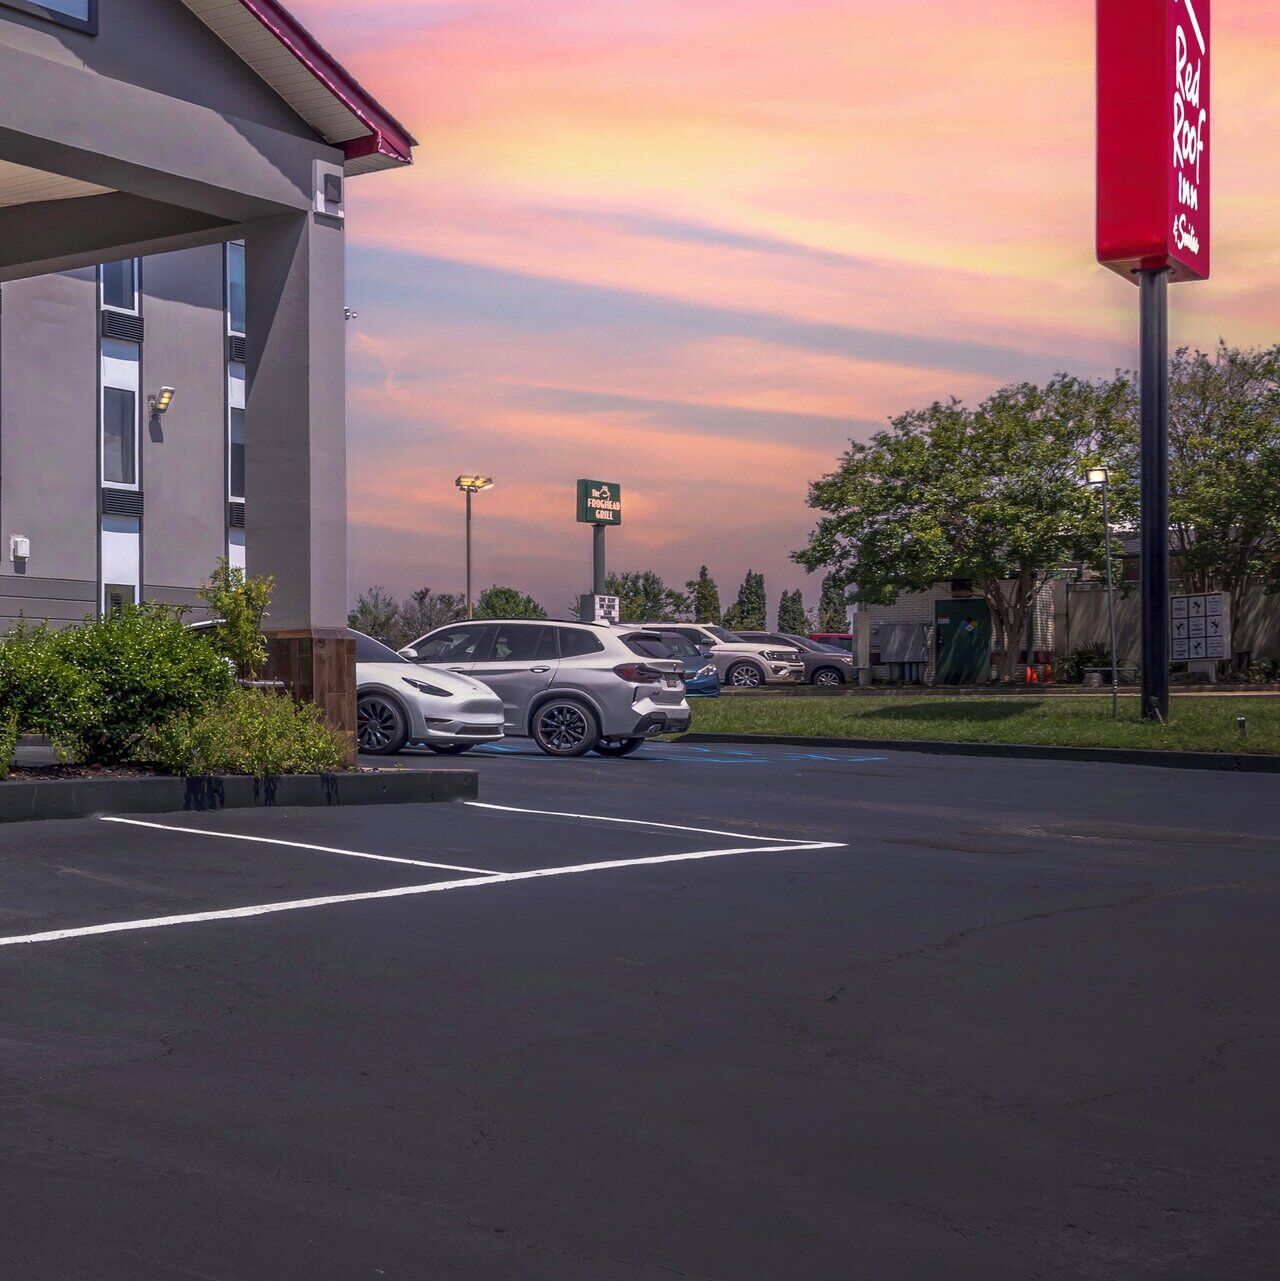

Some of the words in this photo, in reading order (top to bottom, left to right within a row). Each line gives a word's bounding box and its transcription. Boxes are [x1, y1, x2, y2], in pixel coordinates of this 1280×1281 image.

[1175, 24, 1201, 109] Red
[1173, 91, 1206, 185] Roof
[1178, 213, 1199, 255] Suites
[588, 498, 620, 510] FROGHEAD
[596, 510, 613, 520] GRILL
